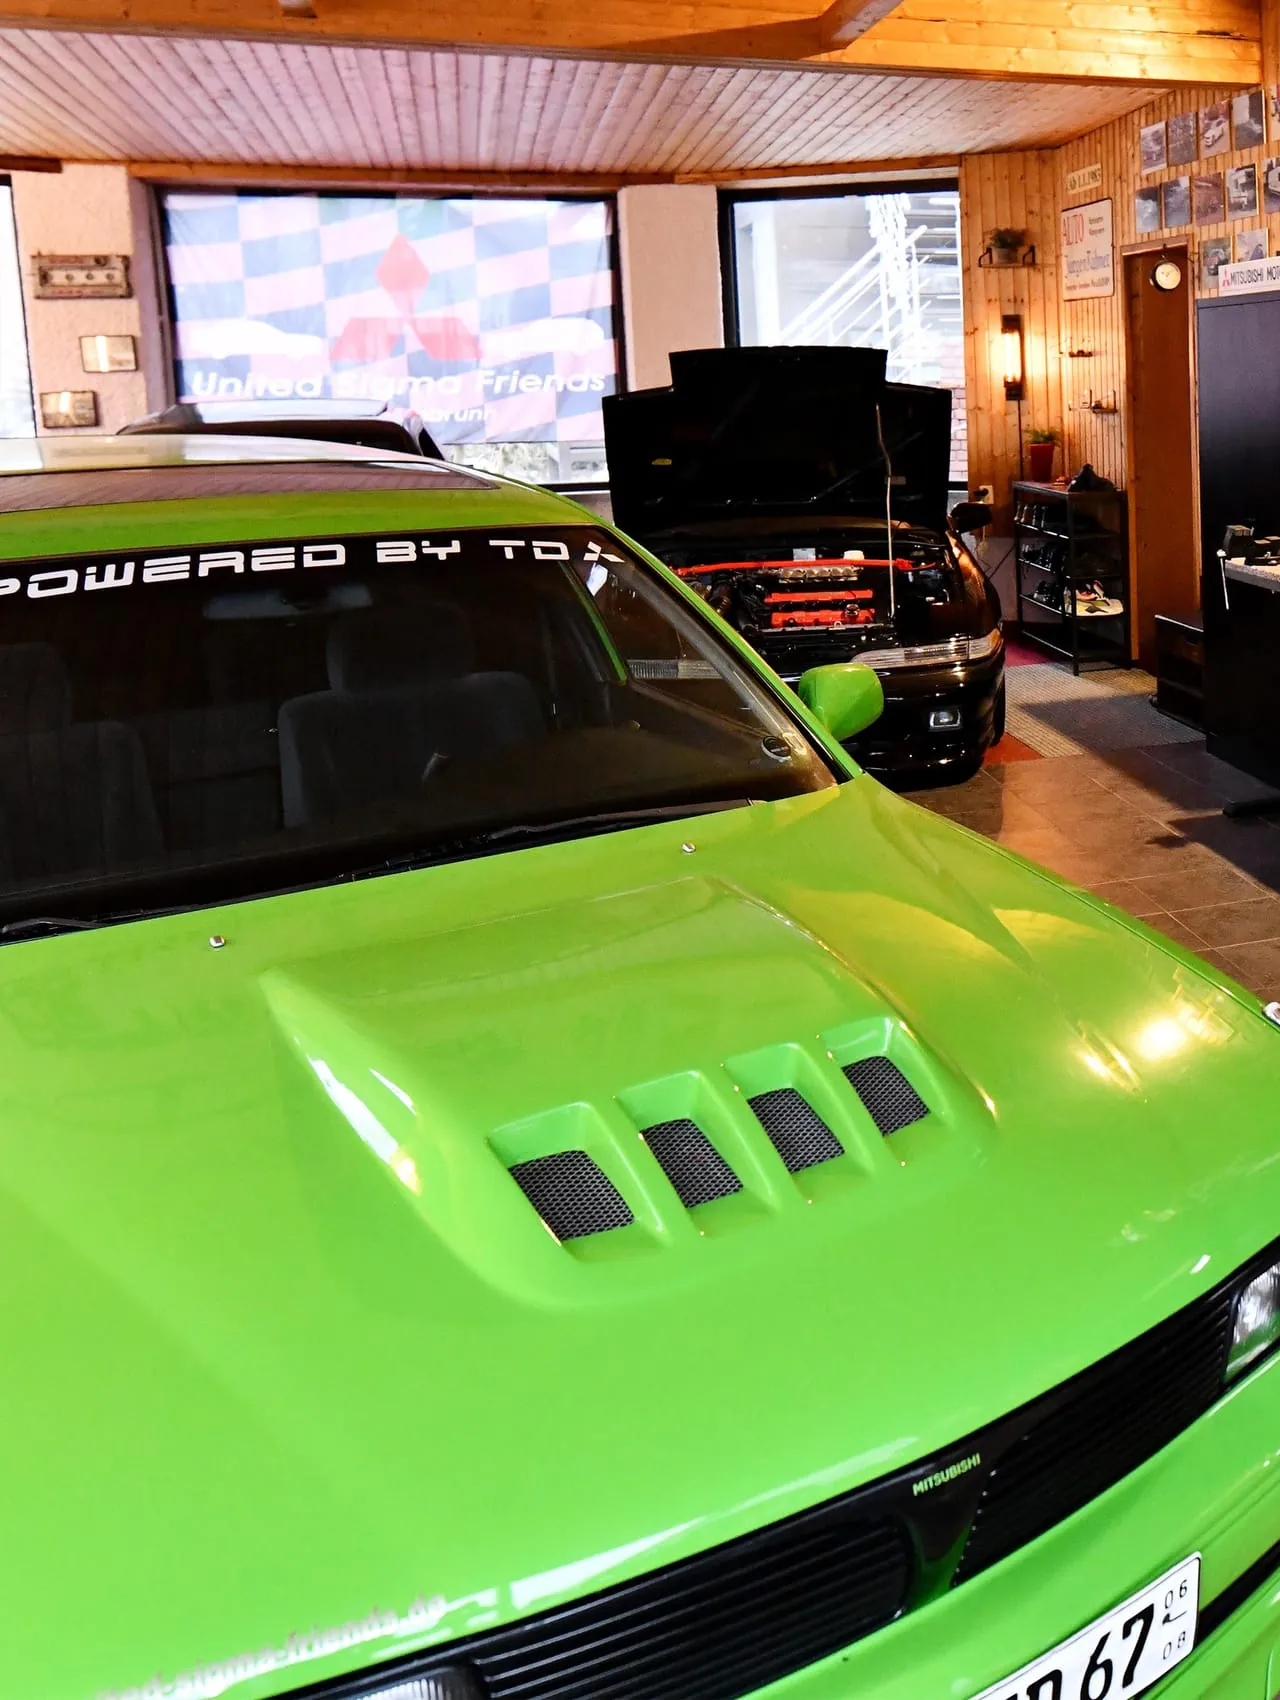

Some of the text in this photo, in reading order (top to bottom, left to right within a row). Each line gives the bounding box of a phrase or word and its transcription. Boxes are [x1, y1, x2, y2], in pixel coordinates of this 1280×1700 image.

[1230, 267, 1265, 285] MITSUBISHI
[191, 367, 607, 402] United Sigma Friends
[376, 540, 461, 563] BY
[912, 1452, 982, 1497] MITSUBISHI
[1164, 1579, 1188, 1609] 06
